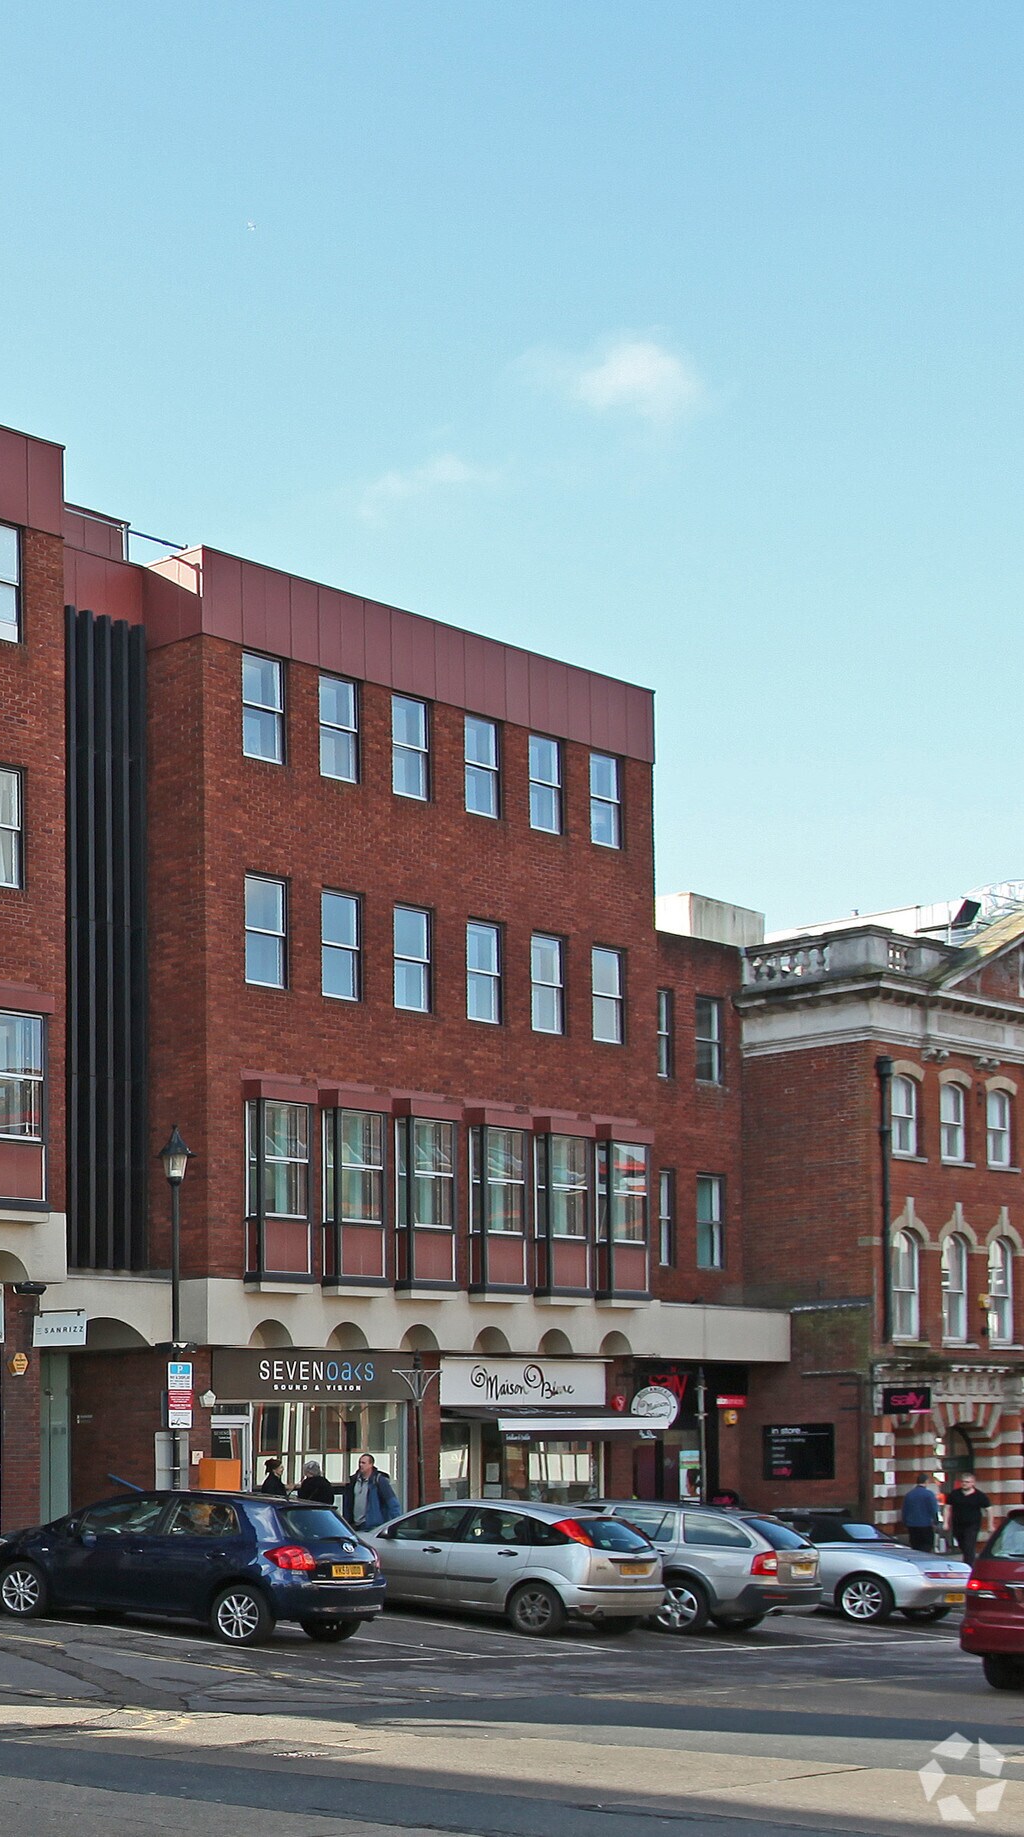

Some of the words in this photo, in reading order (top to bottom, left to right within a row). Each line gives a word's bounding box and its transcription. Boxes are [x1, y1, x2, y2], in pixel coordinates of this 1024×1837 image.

[44, 1325, 84, 1334] SANRIZZ
[177, 1365, 184, 1374] P
[471, 1365, 529, 1400] Maison
[523, 1364, 575, 1399] Blnc
[890, 1392, 925, 1408] sally
